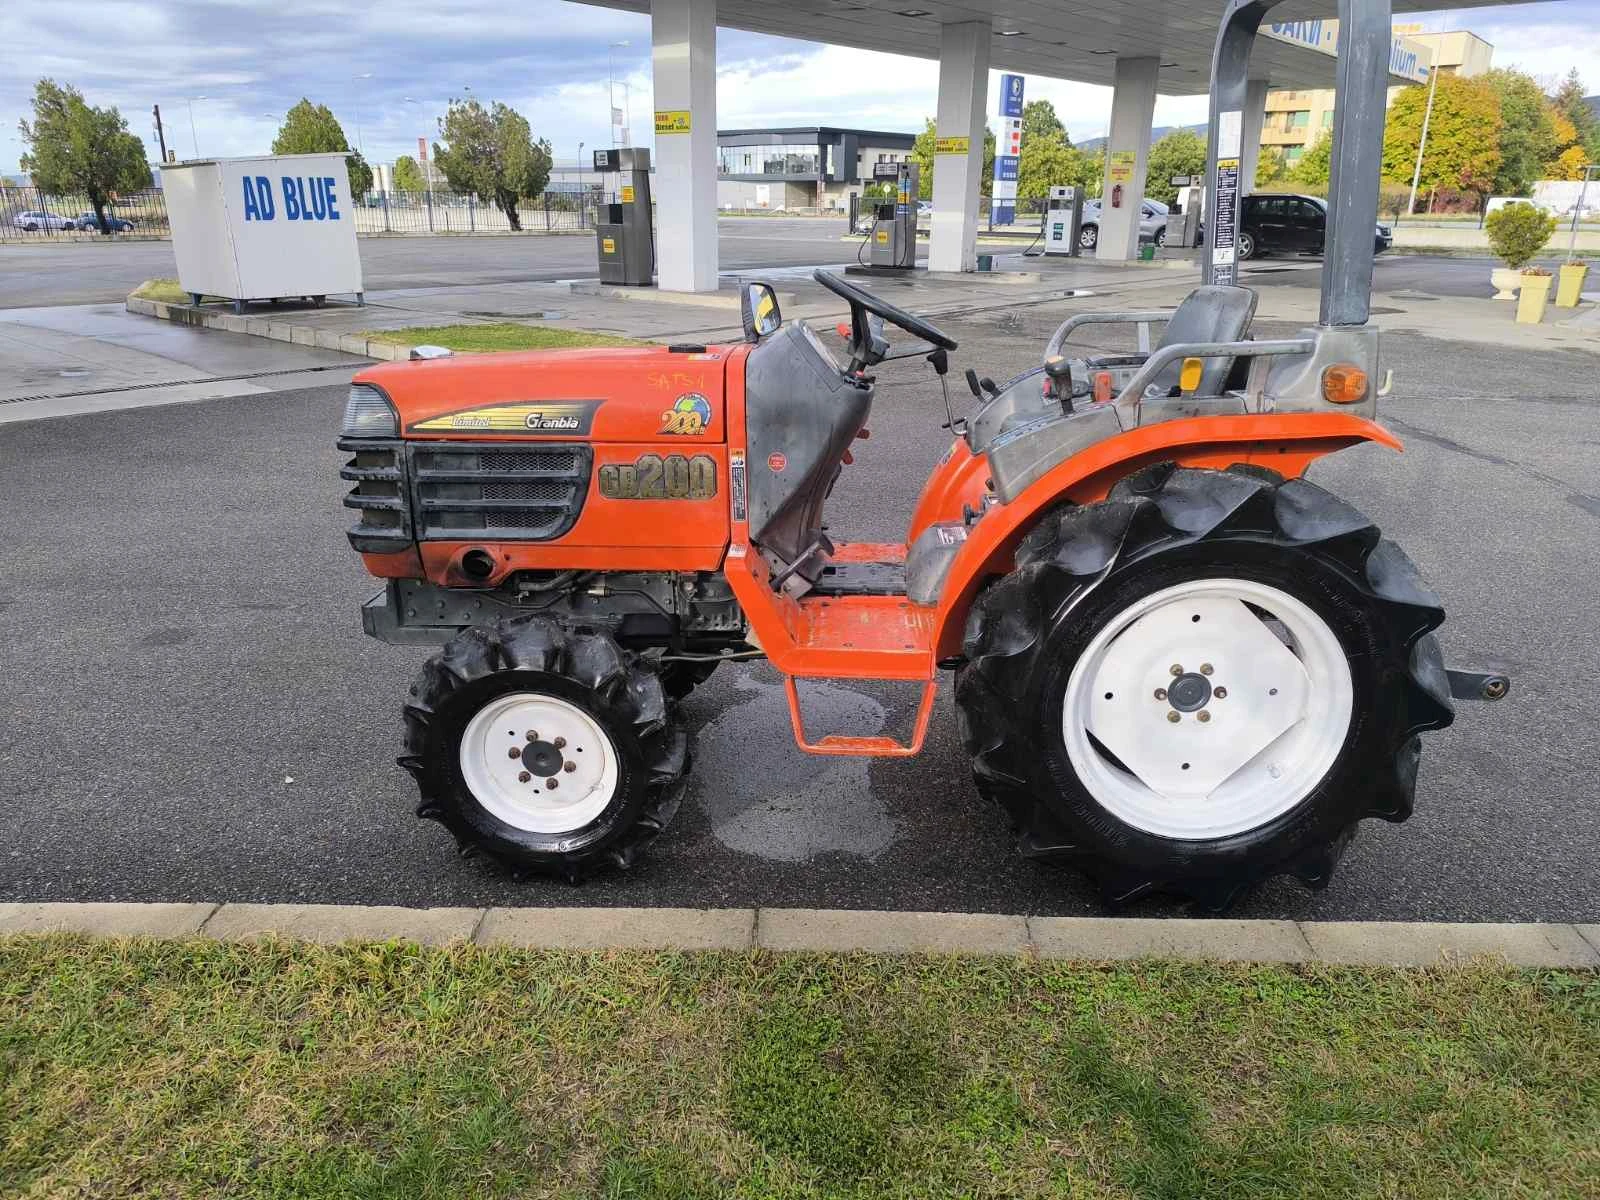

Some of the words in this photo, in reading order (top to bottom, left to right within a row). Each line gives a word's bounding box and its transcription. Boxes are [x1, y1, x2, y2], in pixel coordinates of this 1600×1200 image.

[242, 175, 276, 221] AD
[282, 175, 340, 221] BLUE
[525, 412, 580, 430] Granbia
